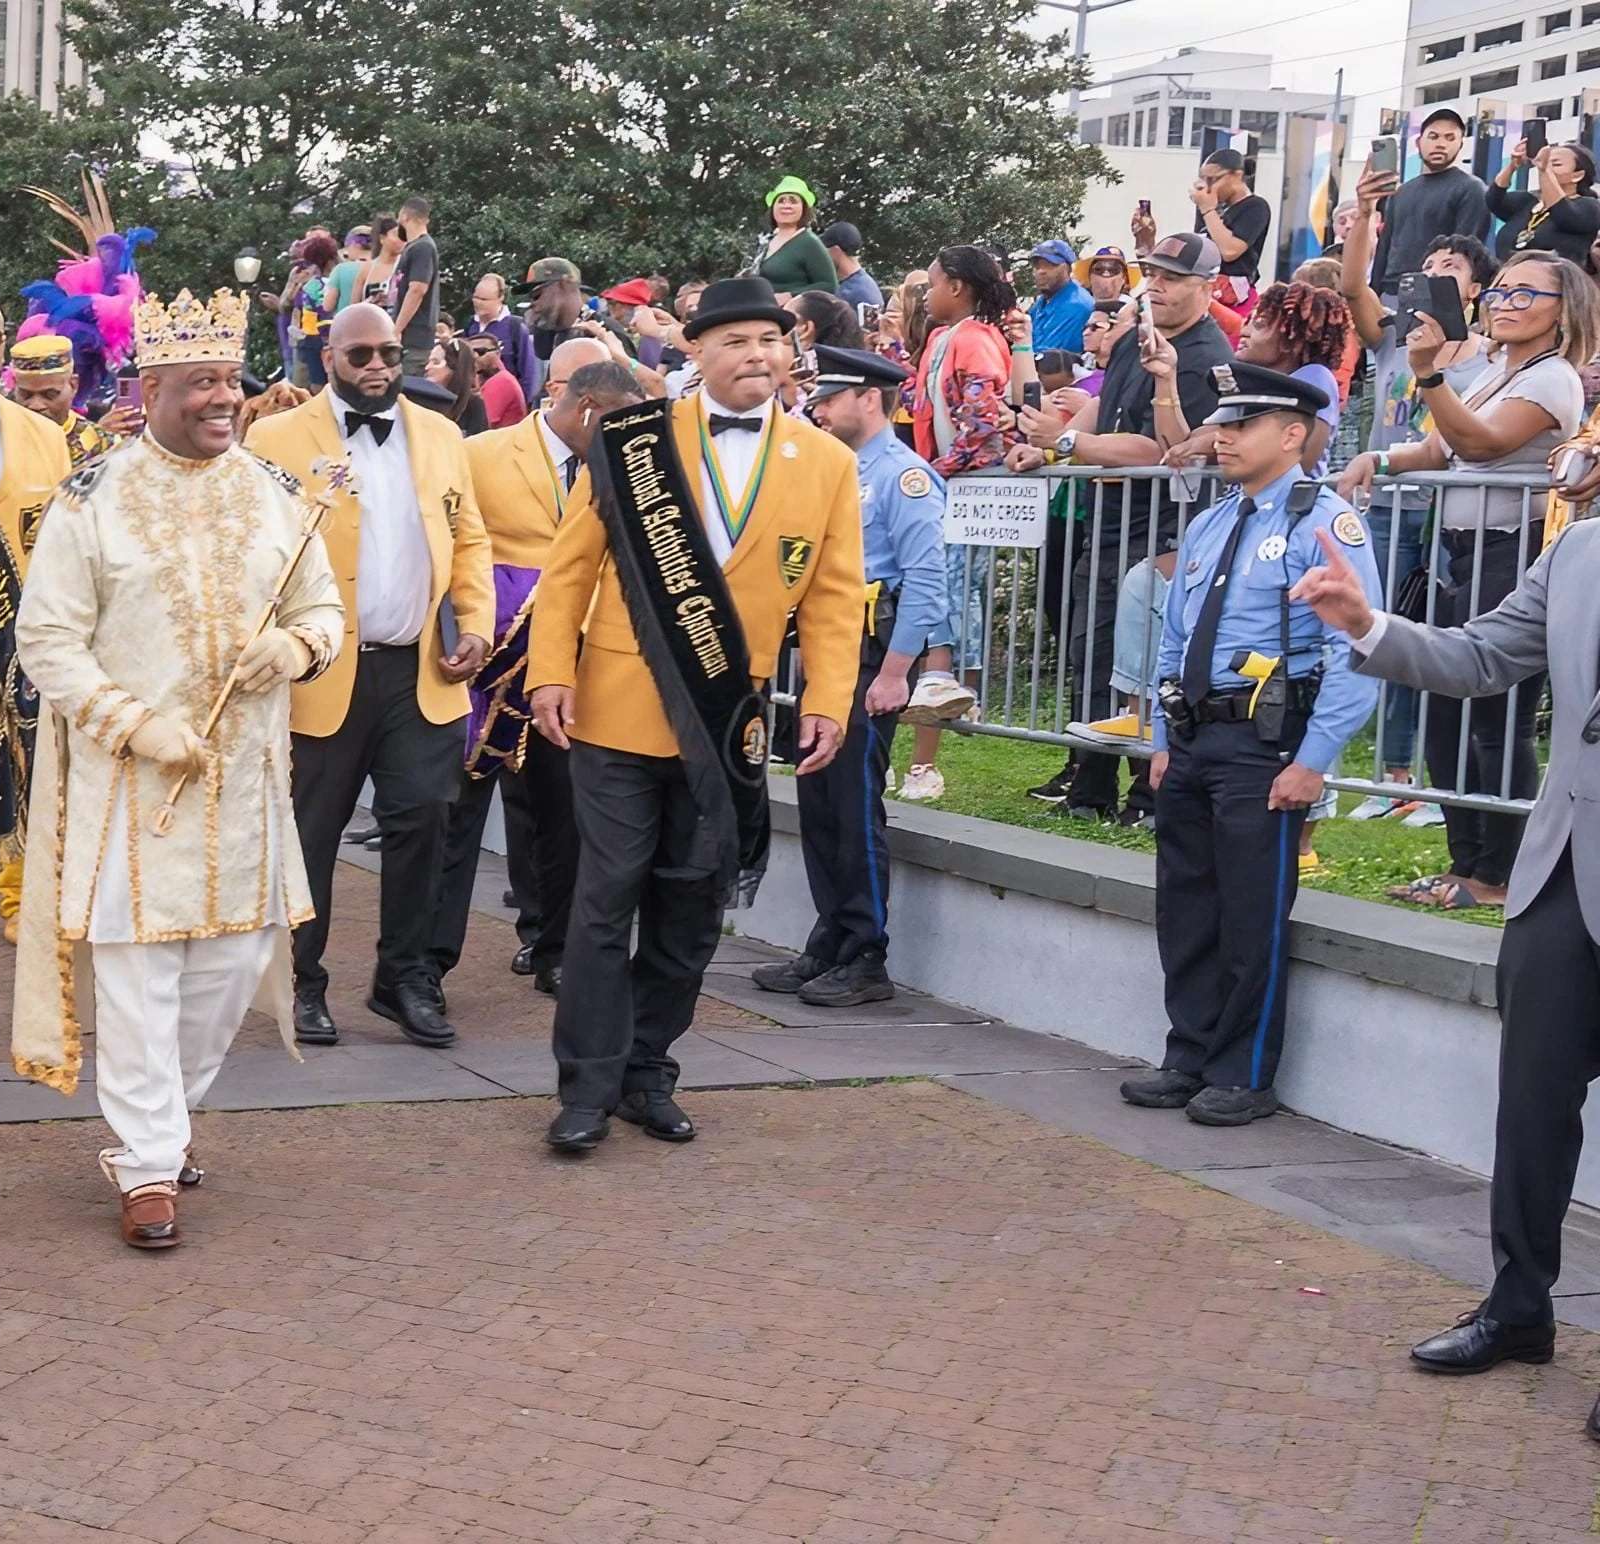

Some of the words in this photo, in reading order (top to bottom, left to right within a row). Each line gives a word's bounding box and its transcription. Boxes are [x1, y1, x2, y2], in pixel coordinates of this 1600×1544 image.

[621, 432, 673, 512] Carnival
[640, 504, 702, 595] Activities
[675, 594, 729, 679] Chairman
